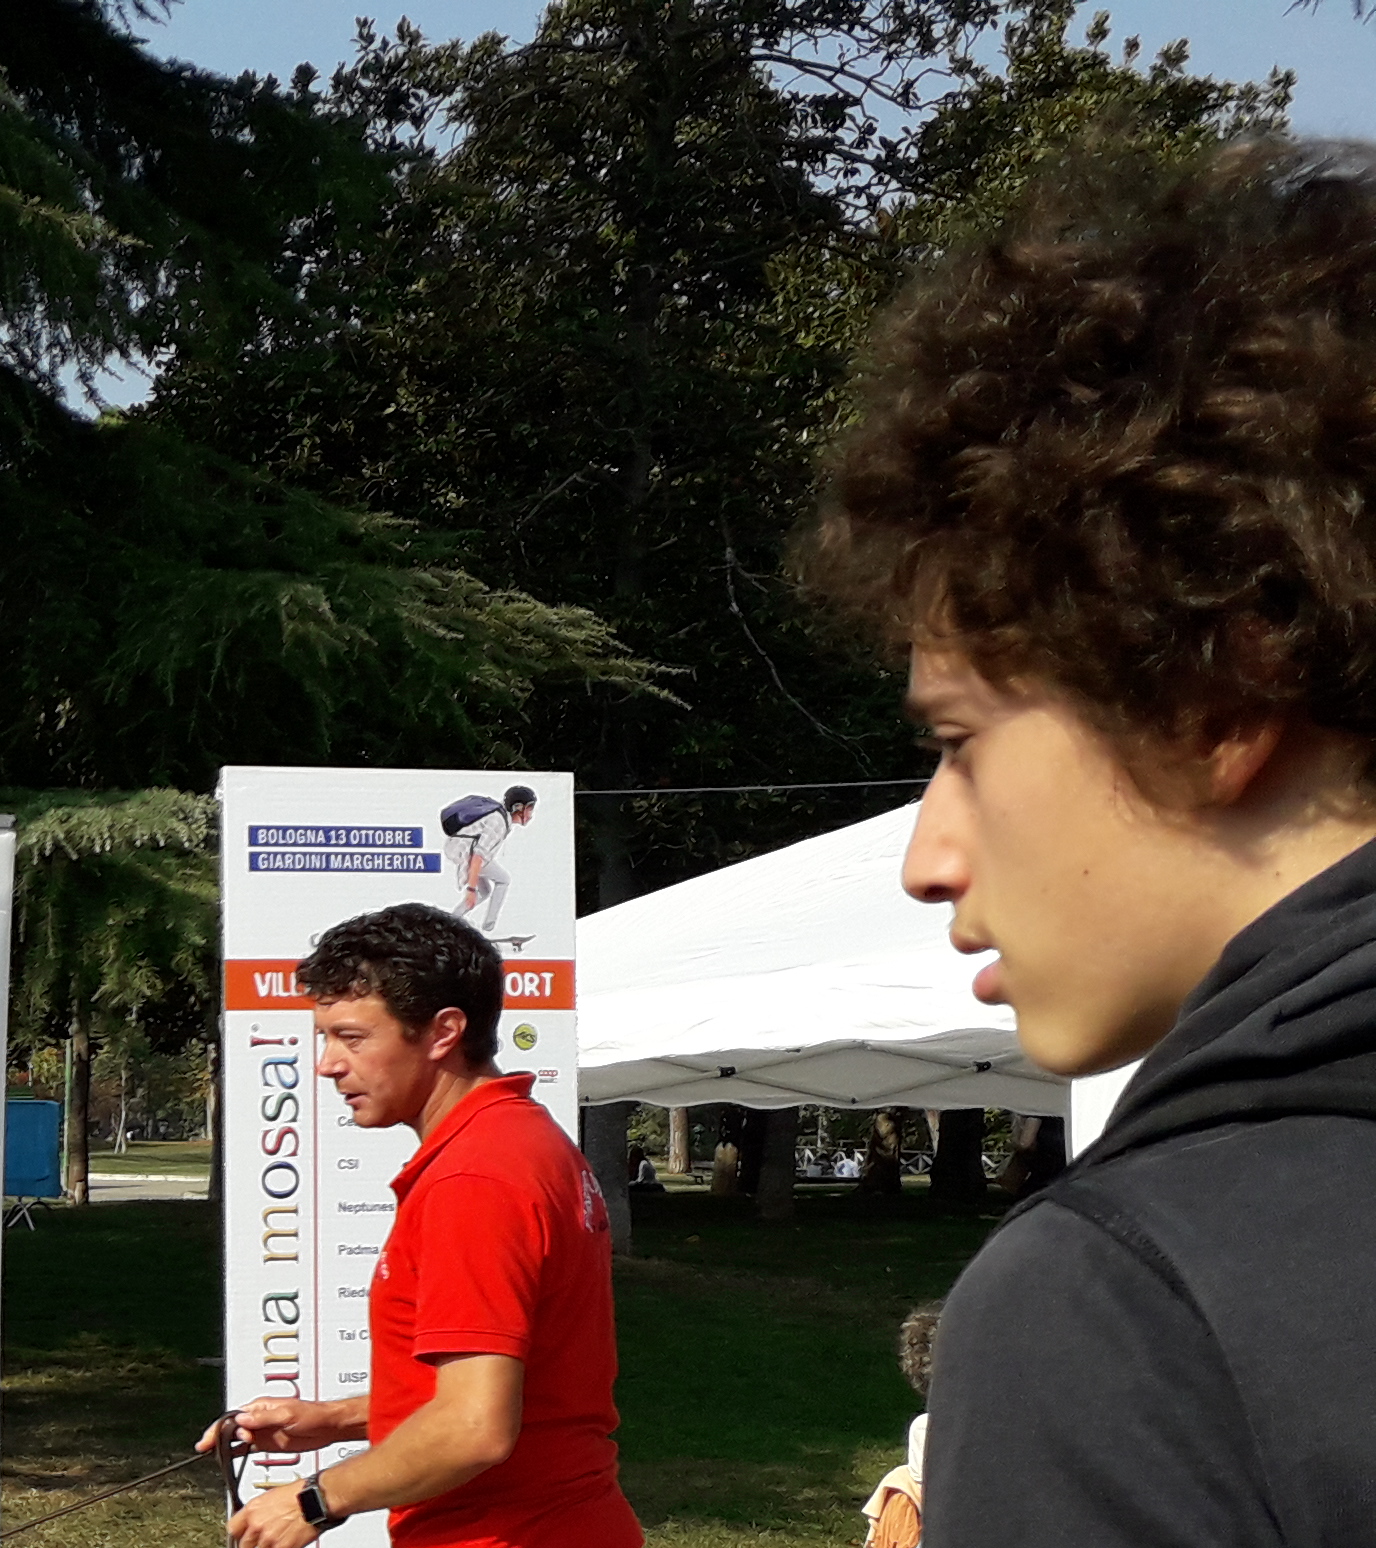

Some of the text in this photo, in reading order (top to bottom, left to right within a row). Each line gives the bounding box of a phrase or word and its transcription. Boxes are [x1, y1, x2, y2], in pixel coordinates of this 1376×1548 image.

[257, 828, 412, 846] BOLOGNA 13 OTTOBRE
[258, 853, 425, 870] GIARDINI MARGHERITA
[253, 971, 555, 998] VILL ORT
[250, 1035, 299, 1265] mossa!
[337, 1158, 360, 1170] CSI
[338, 1244, 379, 1255] Padma
